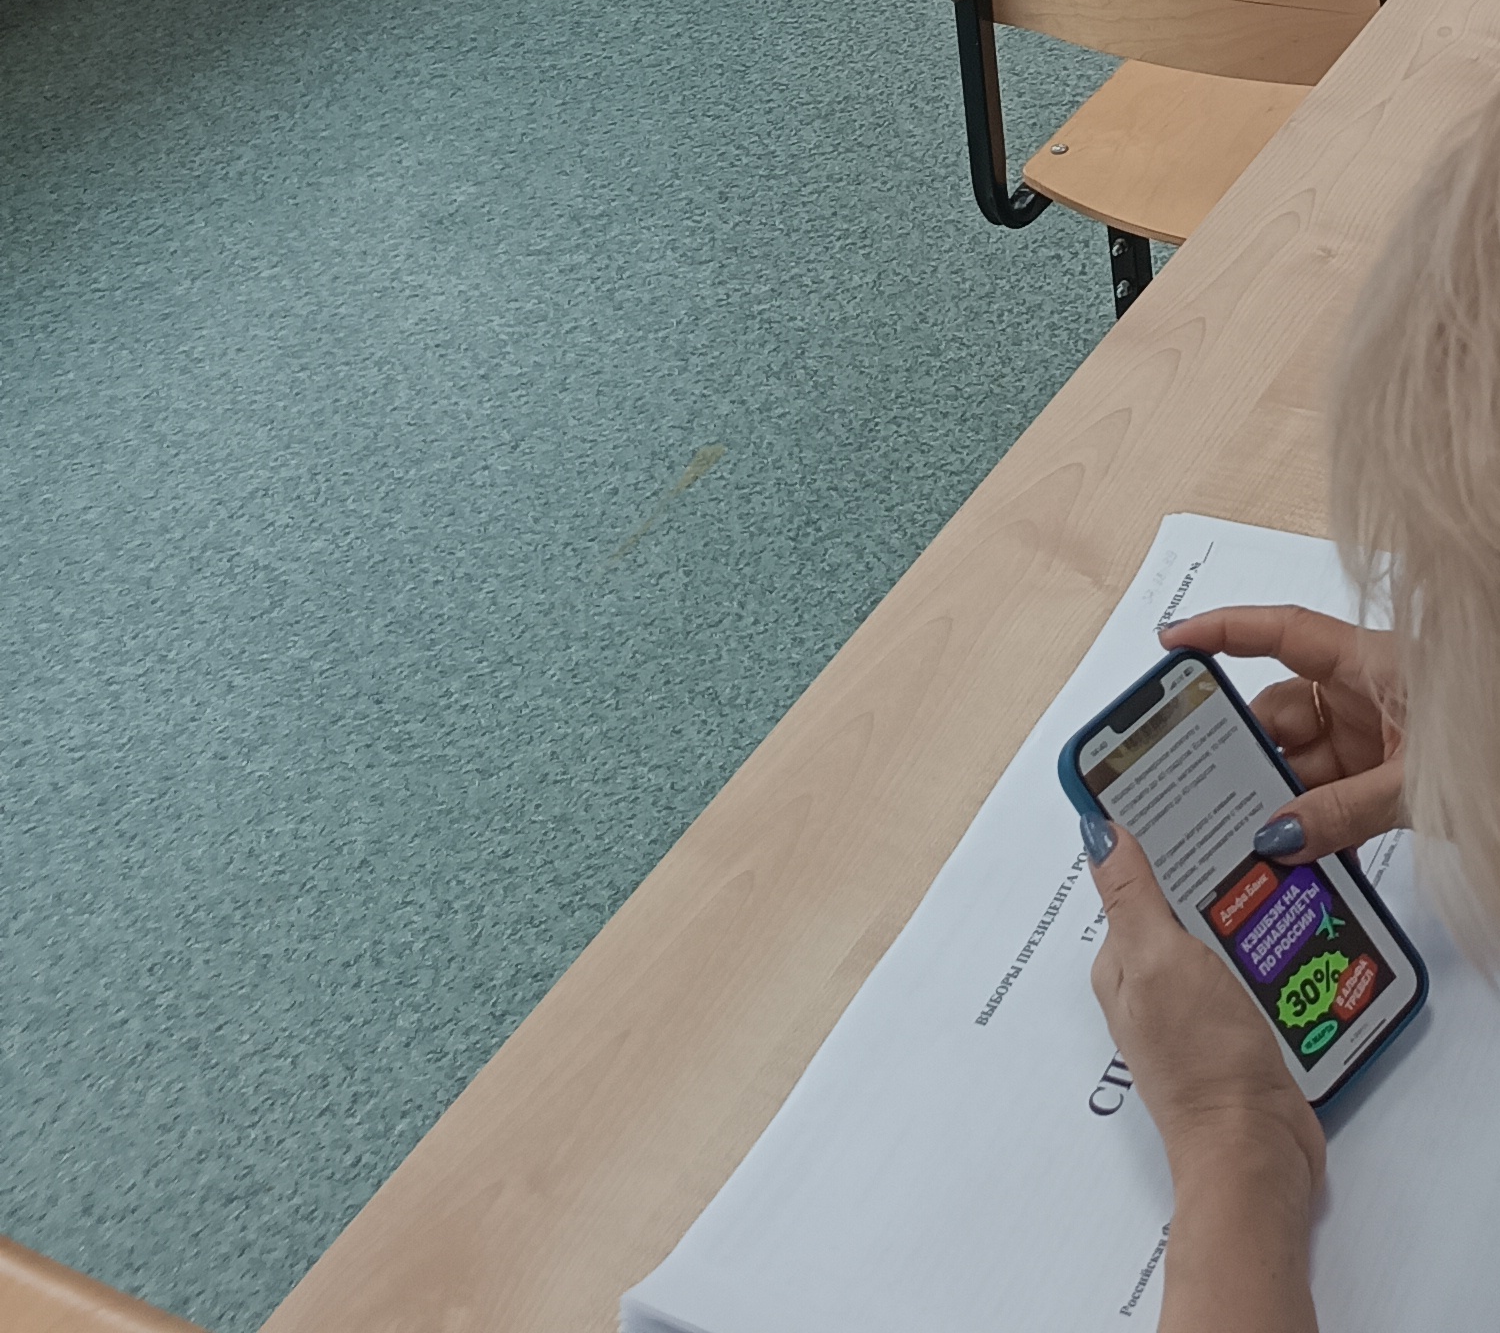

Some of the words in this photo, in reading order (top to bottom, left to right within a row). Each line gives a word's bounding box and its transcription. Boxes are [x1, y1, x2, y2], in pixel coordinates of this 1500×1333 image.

[1219, 893, 1251, 924] Альфа
[1244, 874, 1269, 897] Банк
[1240, 898, 1286, 953] КЭШБЭК
[1281, 884, 1301, 906] НА
[1250, 882, 1320, 965] АВИАБИЛЕТЫ
[975, 965, 1023, 1026] ВЫБОРЫ
[1016, 874, 1079, 964] ПРЕЗИДЕНТА
[1080, 926, 1098, 943] 17
[1258, 956, 1277, 977] ПО
[1274, 908, 1316, 960] РОССИИ
[1286, 959, 1341, 1018] 30%
[1341, 958, 1368, 996] АЛЬФА
[1344, 968, 1374, 1011] ТРЕВЕЛ
[1119, 1238, 1168, 1317] Российская
